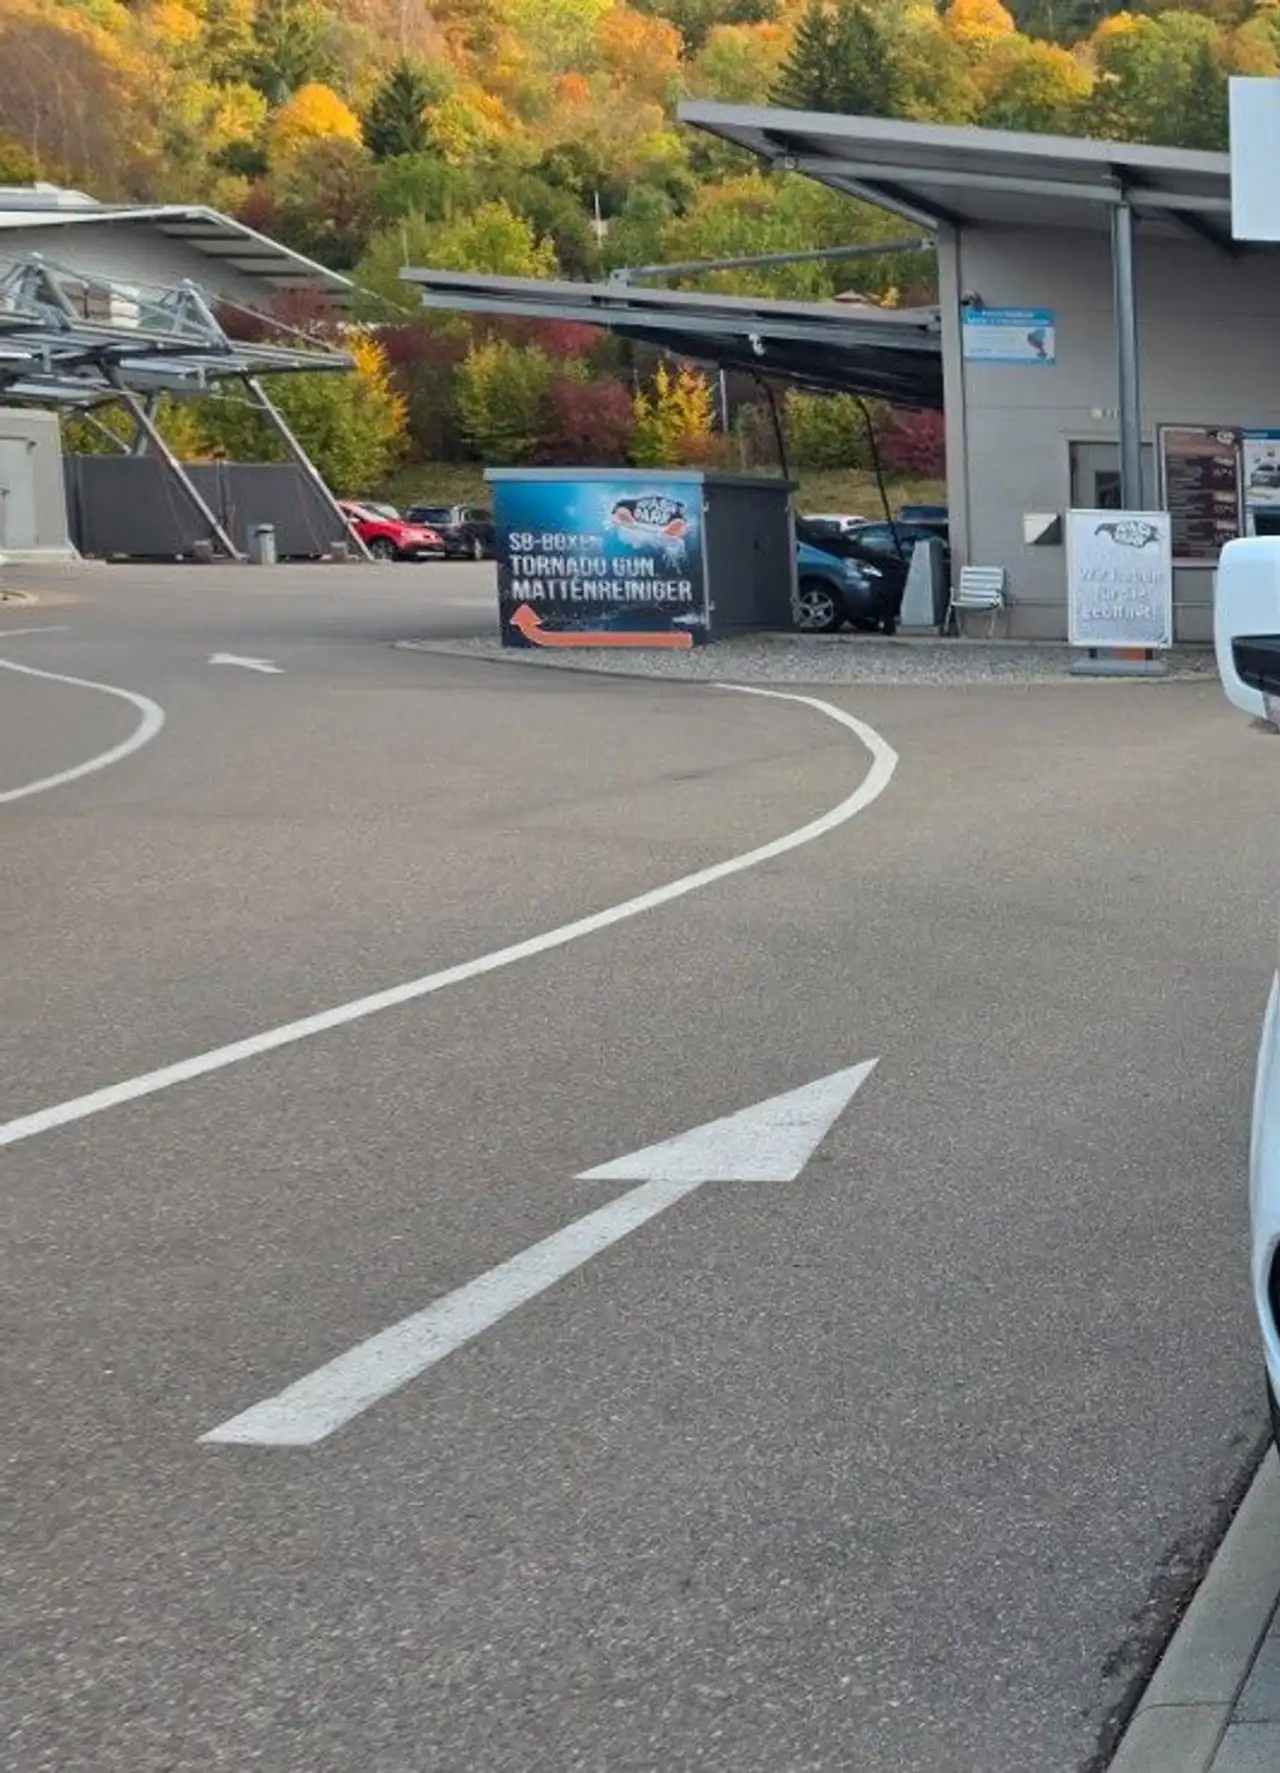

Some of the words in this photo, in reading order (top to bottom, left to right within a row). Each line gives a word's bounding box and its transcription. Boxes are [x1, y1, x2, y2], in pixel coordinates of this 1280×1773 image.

[509, 554, 606, 577] TORNADO
[612, 556, 655, 577] GUN
[511, 578, 692, 600] MATTENREINIGER
